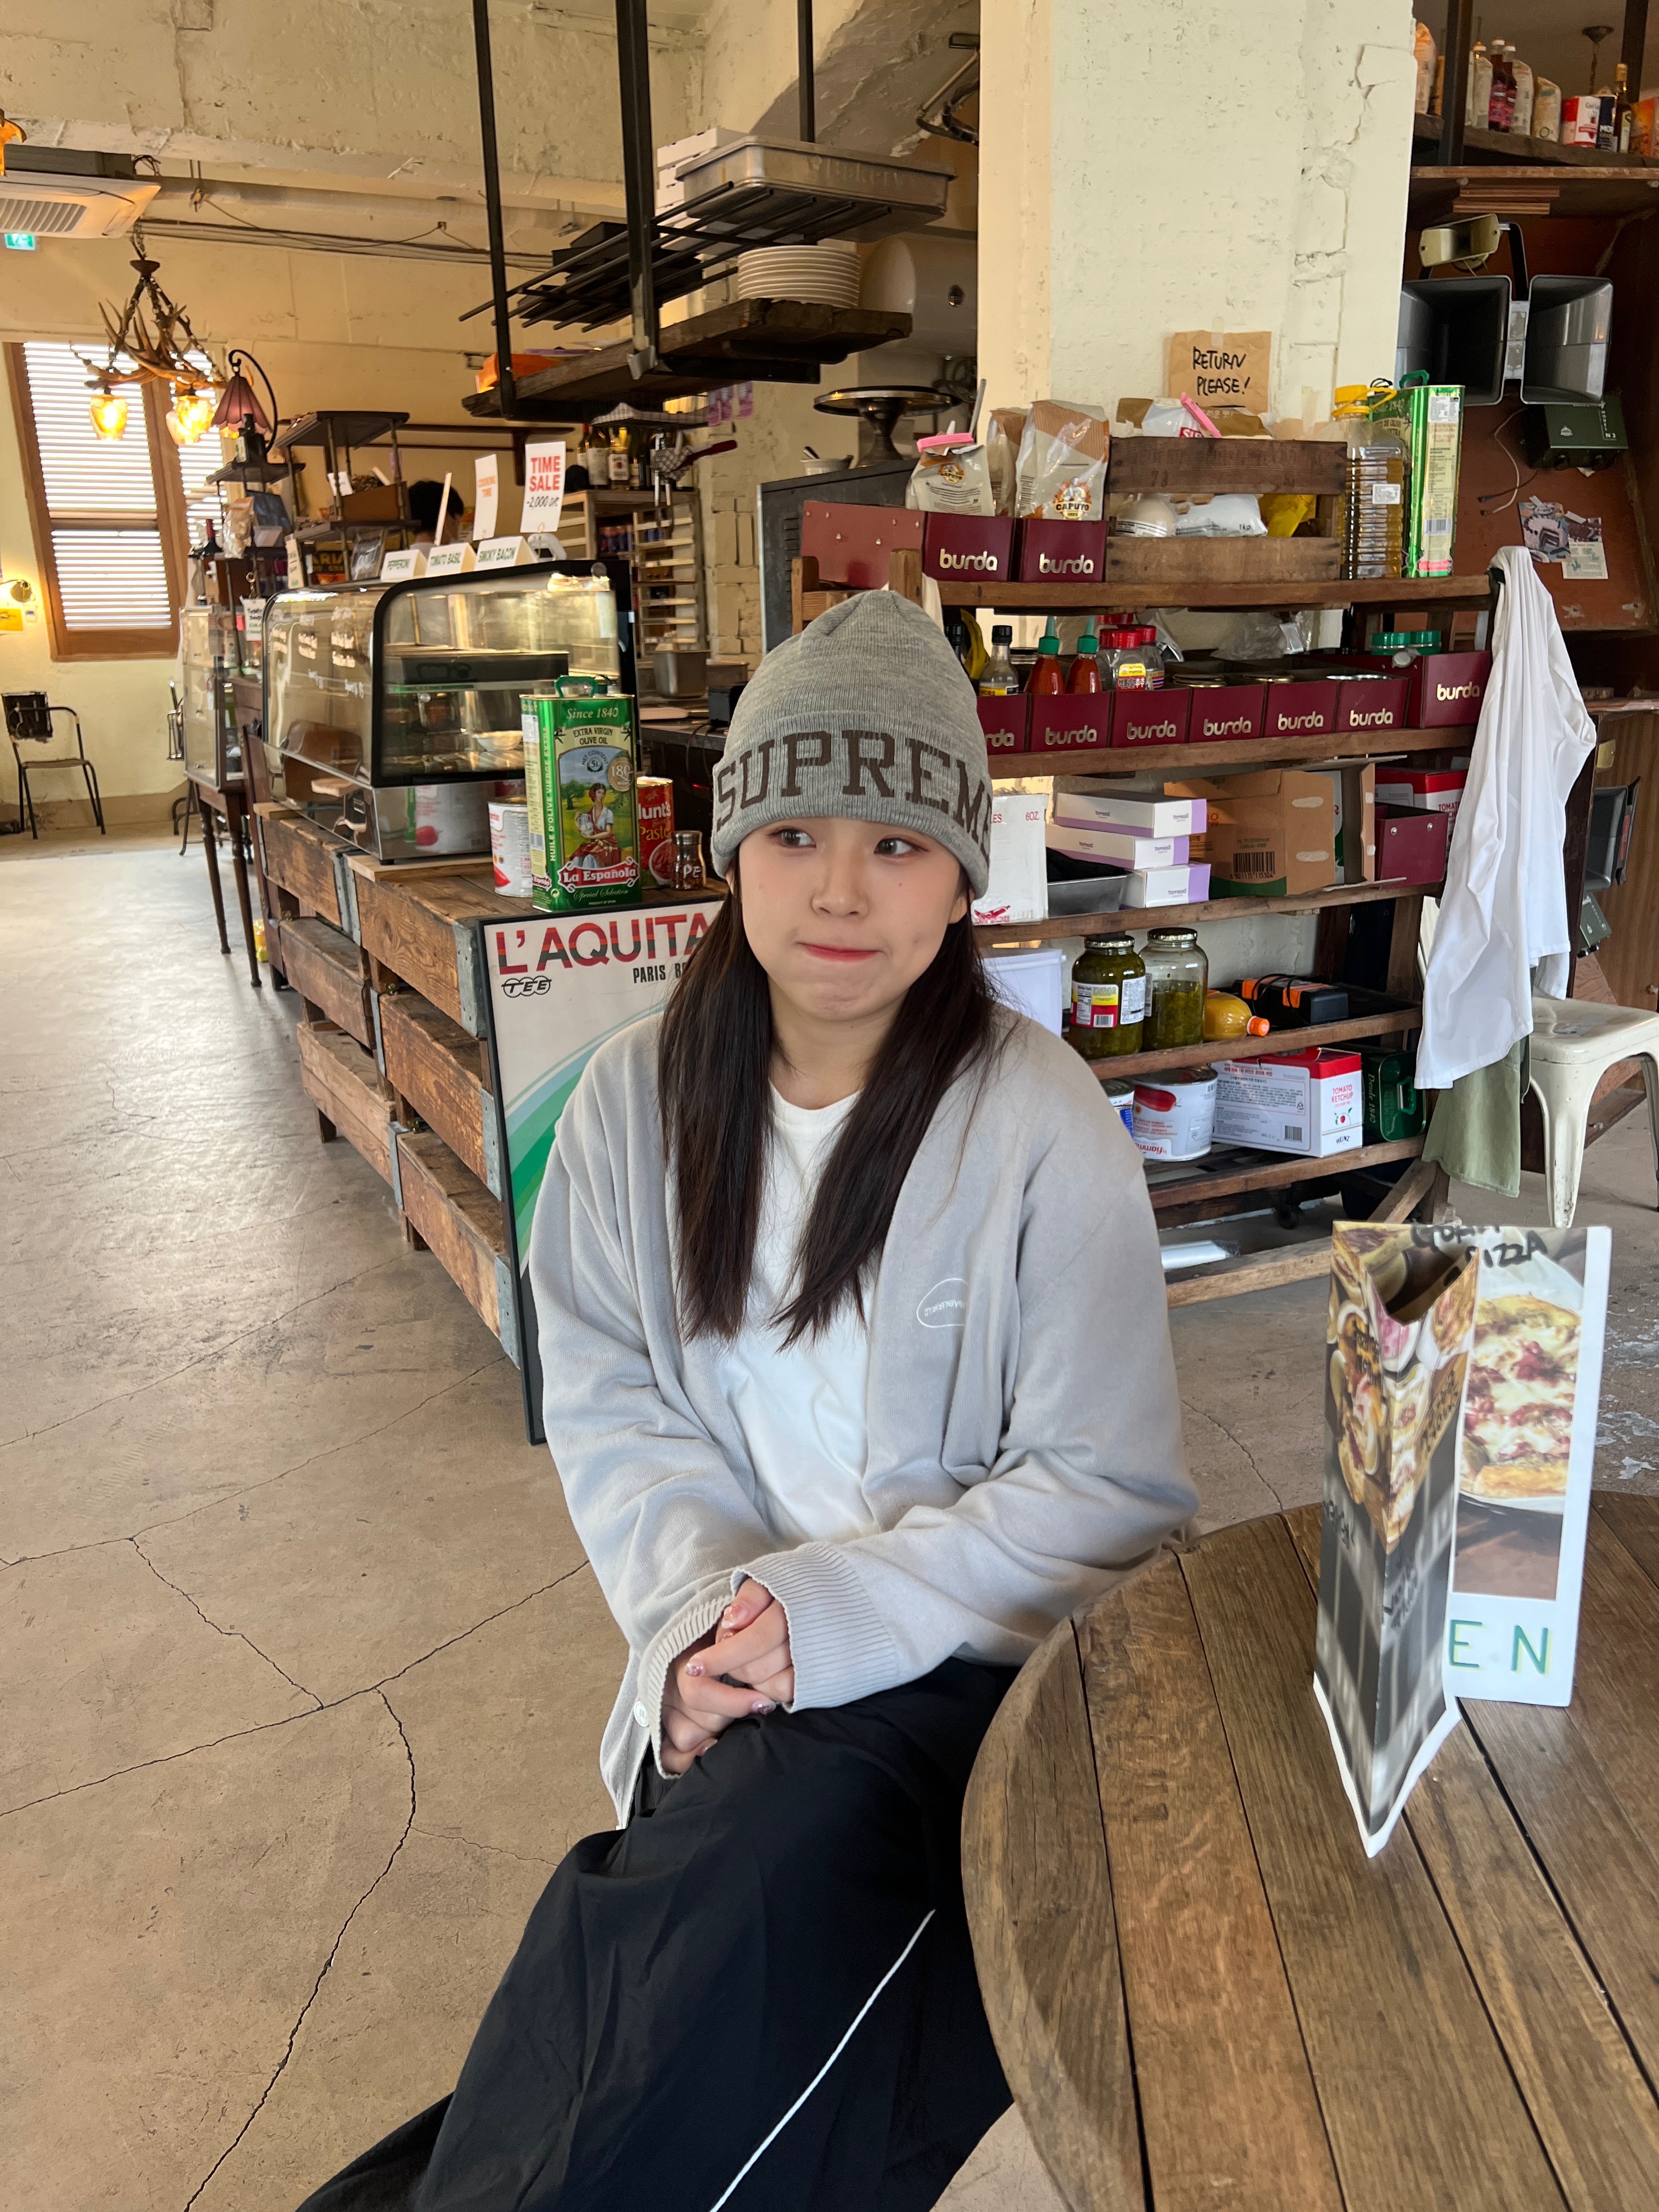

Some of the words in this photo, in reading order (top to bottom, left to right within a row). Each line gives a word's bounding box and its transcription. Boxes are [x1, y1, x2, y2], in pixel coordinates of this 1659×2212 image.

[1193, 346, 1246, 370] RETURN
[1197, 376, 1250, 396] PLEASE!
[530, 456, 561, 473] TIME
[529, 475, 560, 492] SALE
[1056, 503, 1090, 511] CAPUTO
[939, 548, 998, 571] burda
[1039, 553, 1094, 574] burda
[1436, 681, 1480, 701] burda
[567, 708, 594, 719] Since
[596, 708, 619, 718] 1840
[1278, 711, 1324, 730] burda
[1349, 708, 1393, 727] burda
[573, 727, 592, 738] EXTRA
[594, 727, 613, 736] VIRGIN
[1126, 720, 1176, 740] burda
[1203, 716, 1252, 736] burda
[579, 737, 597, 746] OLIVE
[985, 729, 1014, 747] rda
[1045, 725, 1097, 746] burda
[991, 814, 1002, 823] ES
[639, 826, 669, 841] Paste
[563, 872, 579, 883] La
[583, 867, 636, 882] Española
[495, 912, 711, 975] L'AQUITA
[633, 964, 666, 984] PARIS
[501, 977, 552, 996] TEE
[1331, 1092, 1353, 1103] KETCHUP
[1332, 1084, 1352, 1095] TOMATO
[1336, 1136, 1350, 1144] HEINZ
